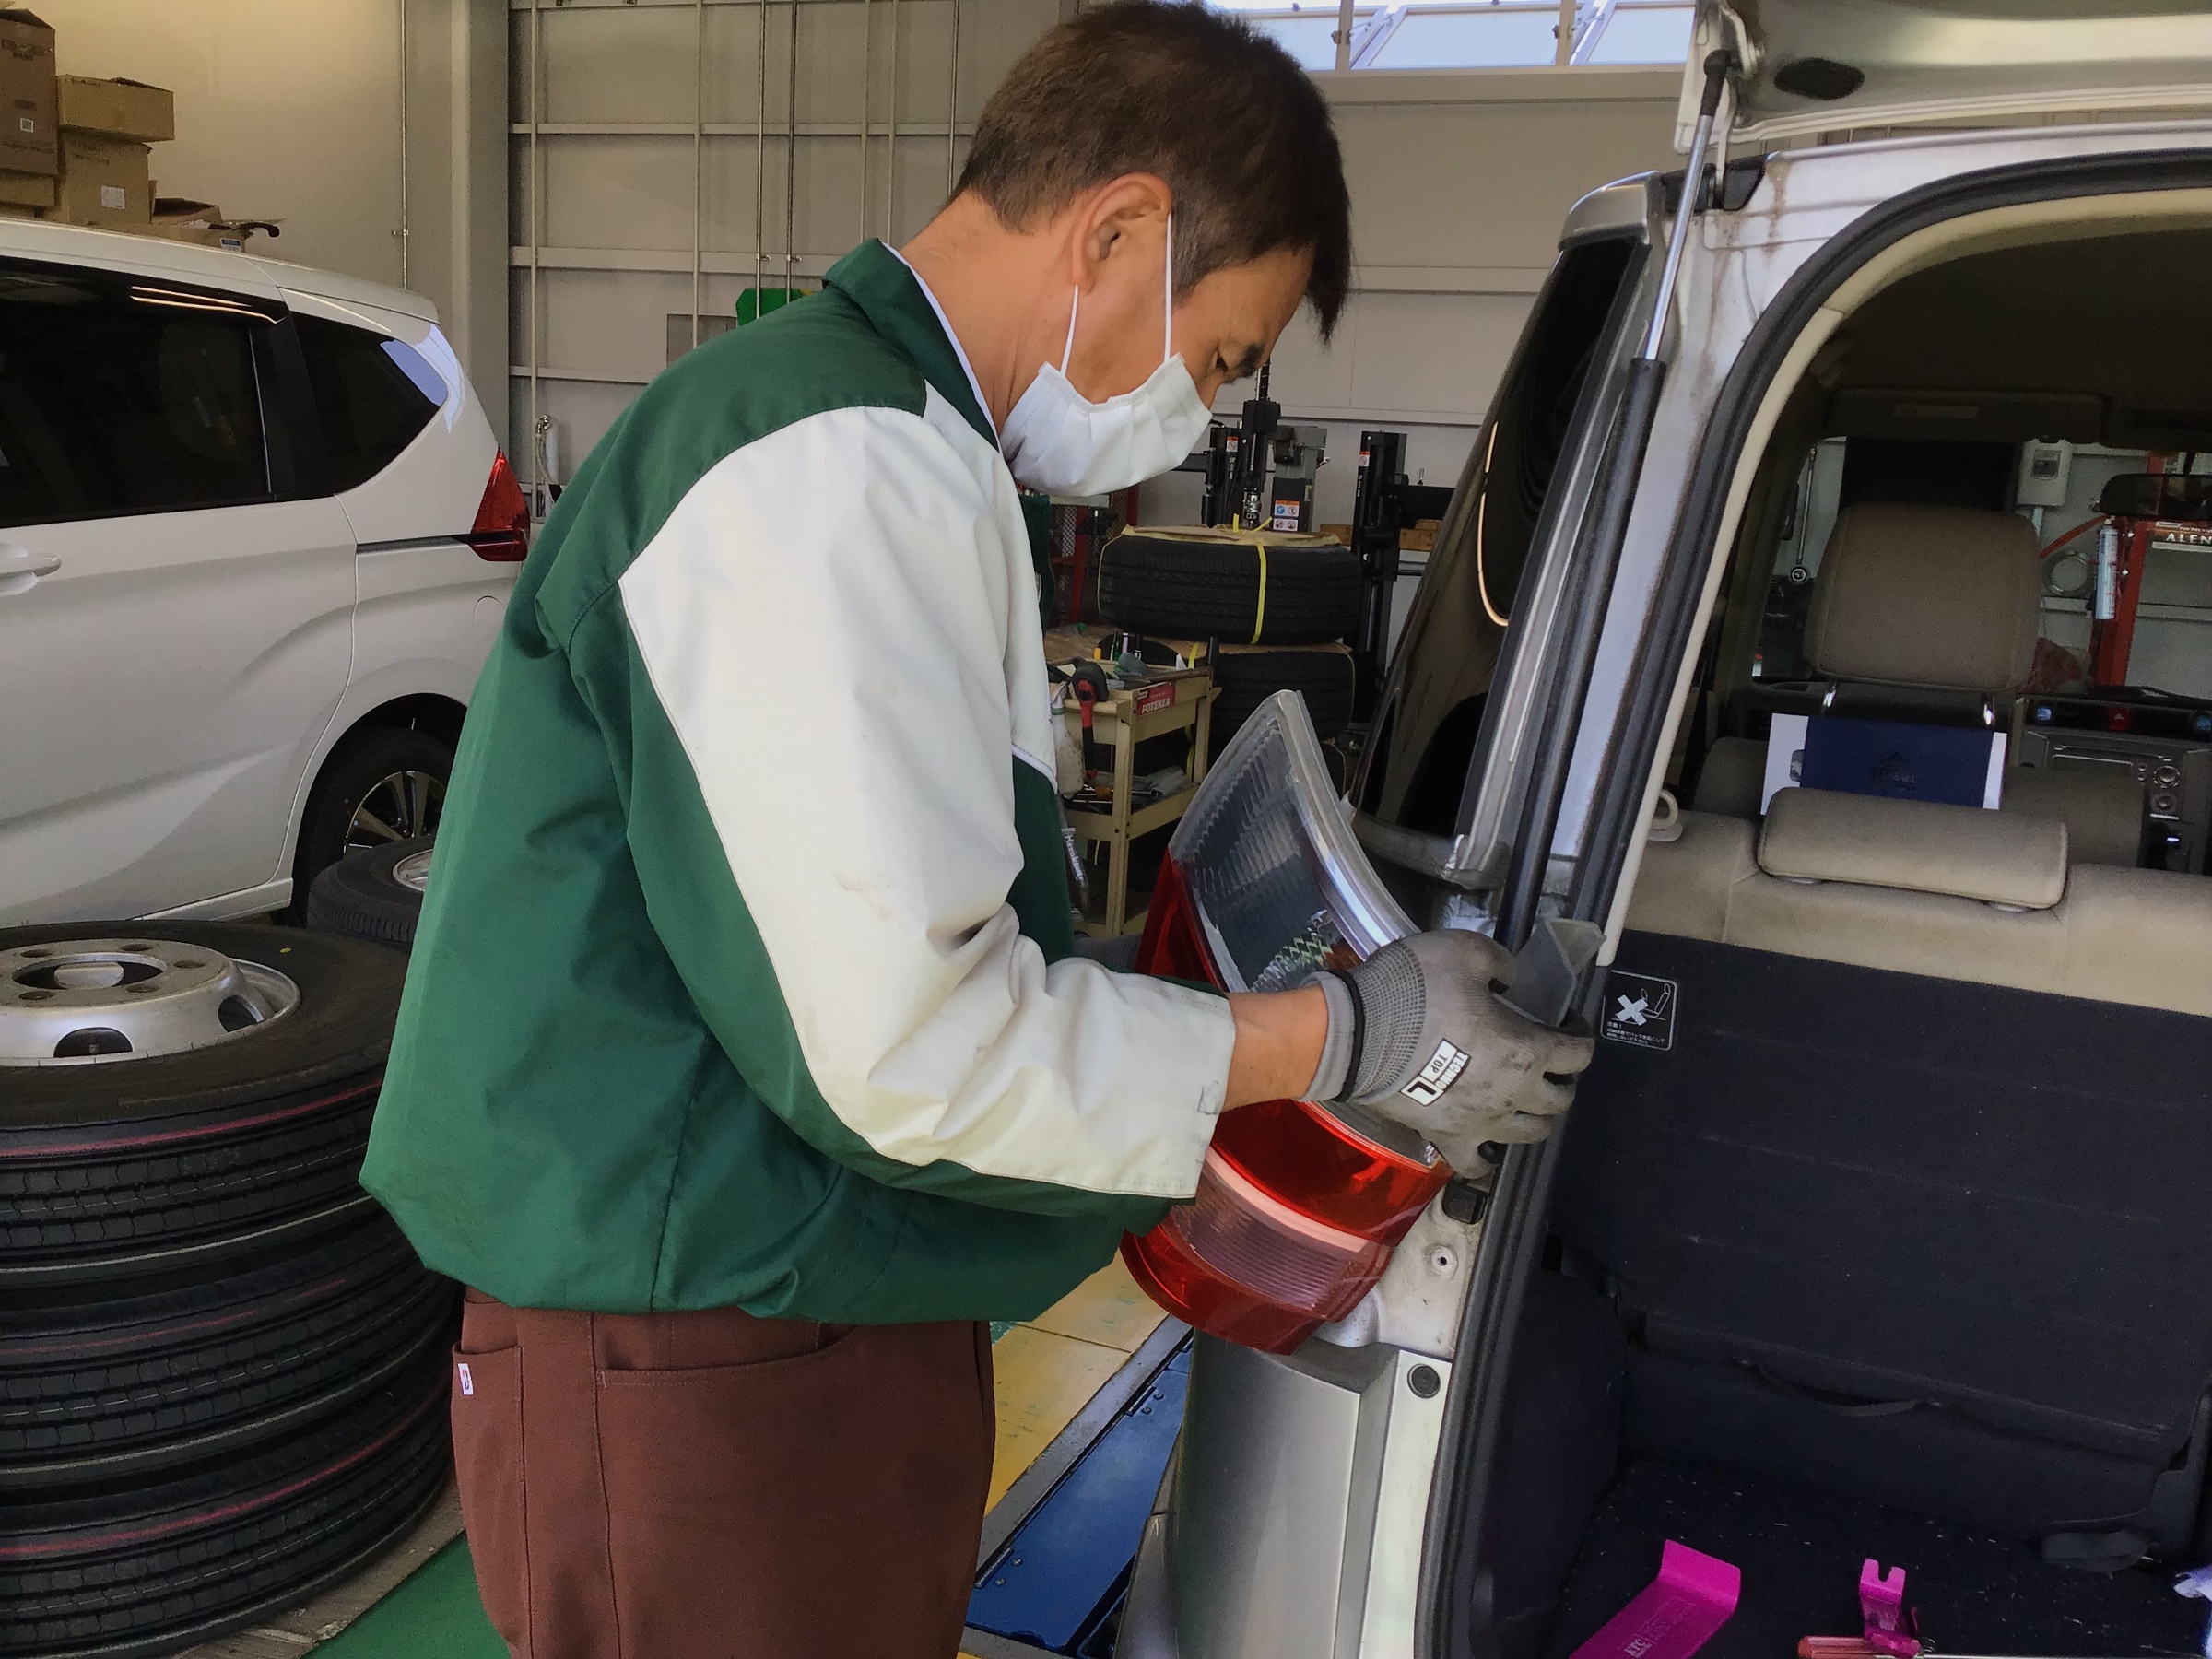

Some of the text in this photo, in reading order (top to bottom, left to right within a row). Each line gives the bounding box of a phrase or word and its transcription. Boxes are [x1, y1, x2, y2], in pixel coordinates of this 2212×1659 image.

[1141, 697, 1171, 714] POTENZA
[1430, 1054, 1448, 1074] TOP
[1434, 1051, 1469, 1090] TECHNO
[1406, 1080, 1437, 1096] L
[1624, 1638, 1647, 1657] KTC
